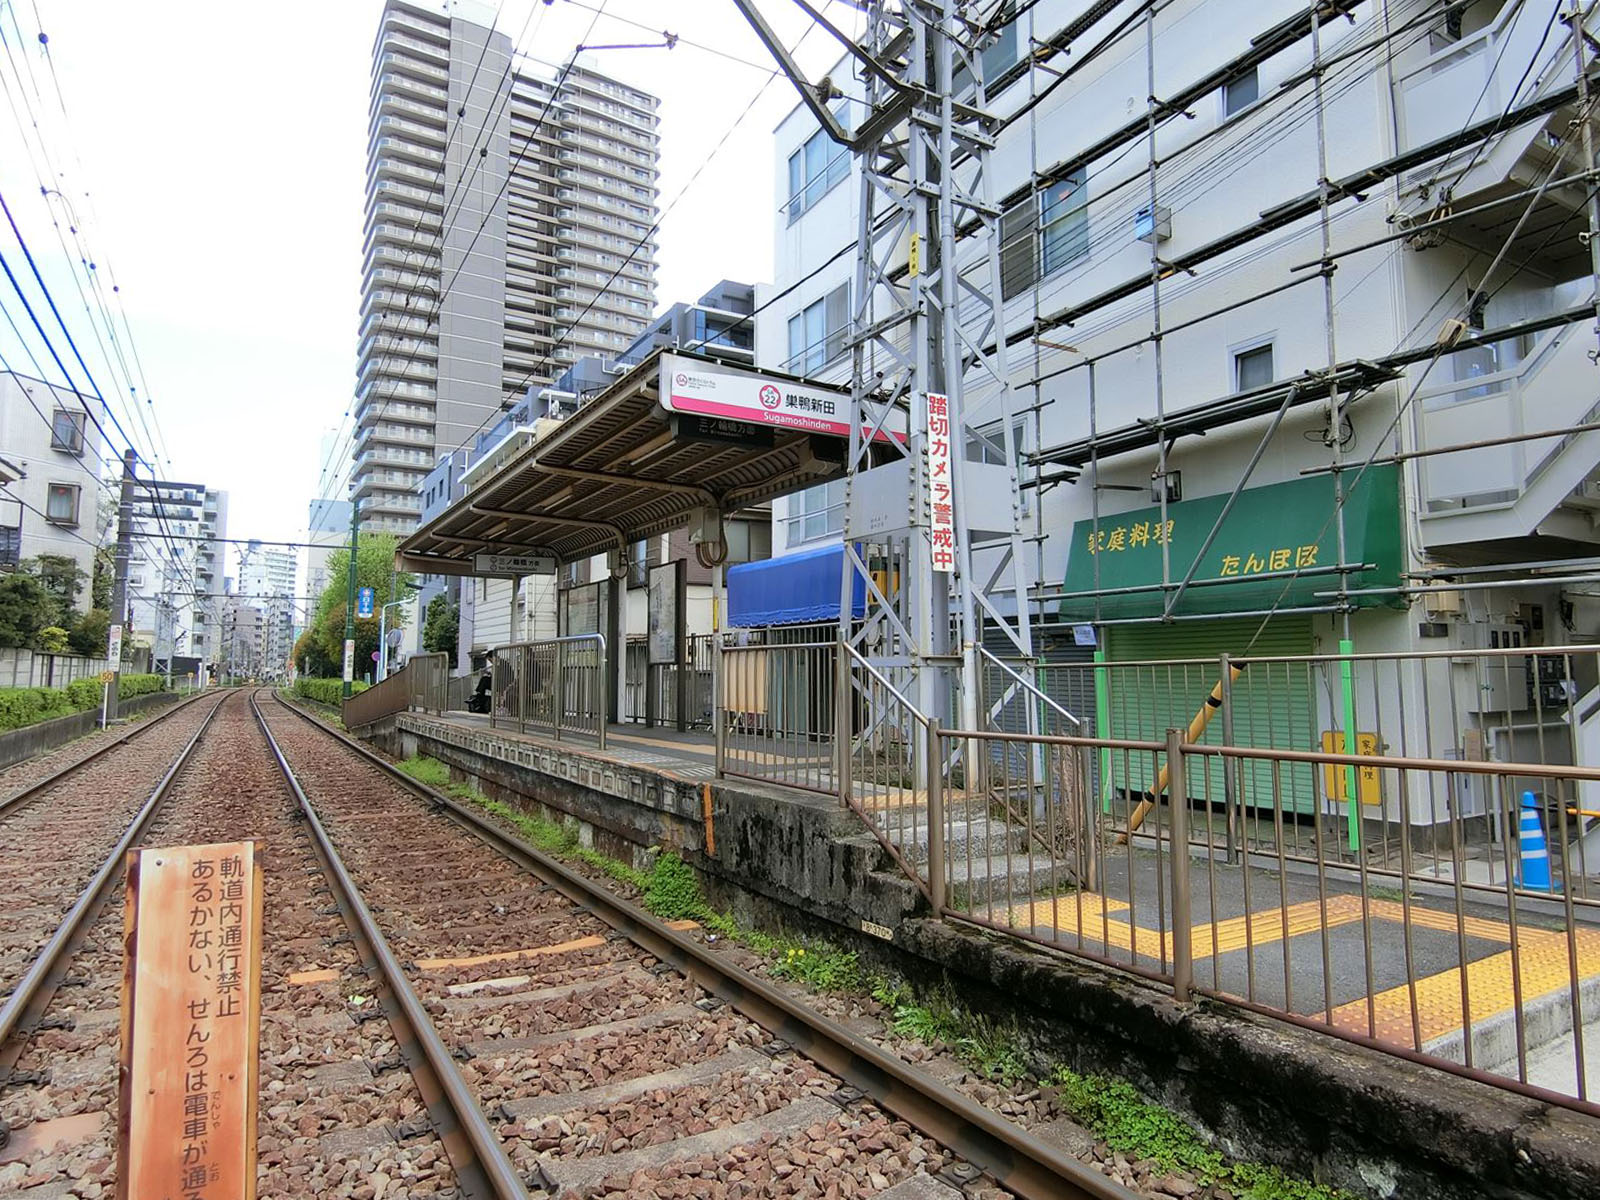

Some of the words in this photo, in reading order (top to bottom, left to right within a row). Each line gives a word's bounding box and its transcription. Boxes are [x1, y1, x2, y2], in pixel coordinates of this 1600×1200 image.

[764, 395, 776, 405] 22
[785, 393, 835, 415] 巣鴨新田
[763, 411, 832, 430] Sugamoshinden
[929, 395, 952, 569] 踏切カメラ警戒中
[1088, 520, 1175, 555] 家庭料理
[102, 672, 113, 681] 50
[215, 855, 245, 1018] 軌道内通行禁止
[209, 1090, 221, 1130] でんしゃ
